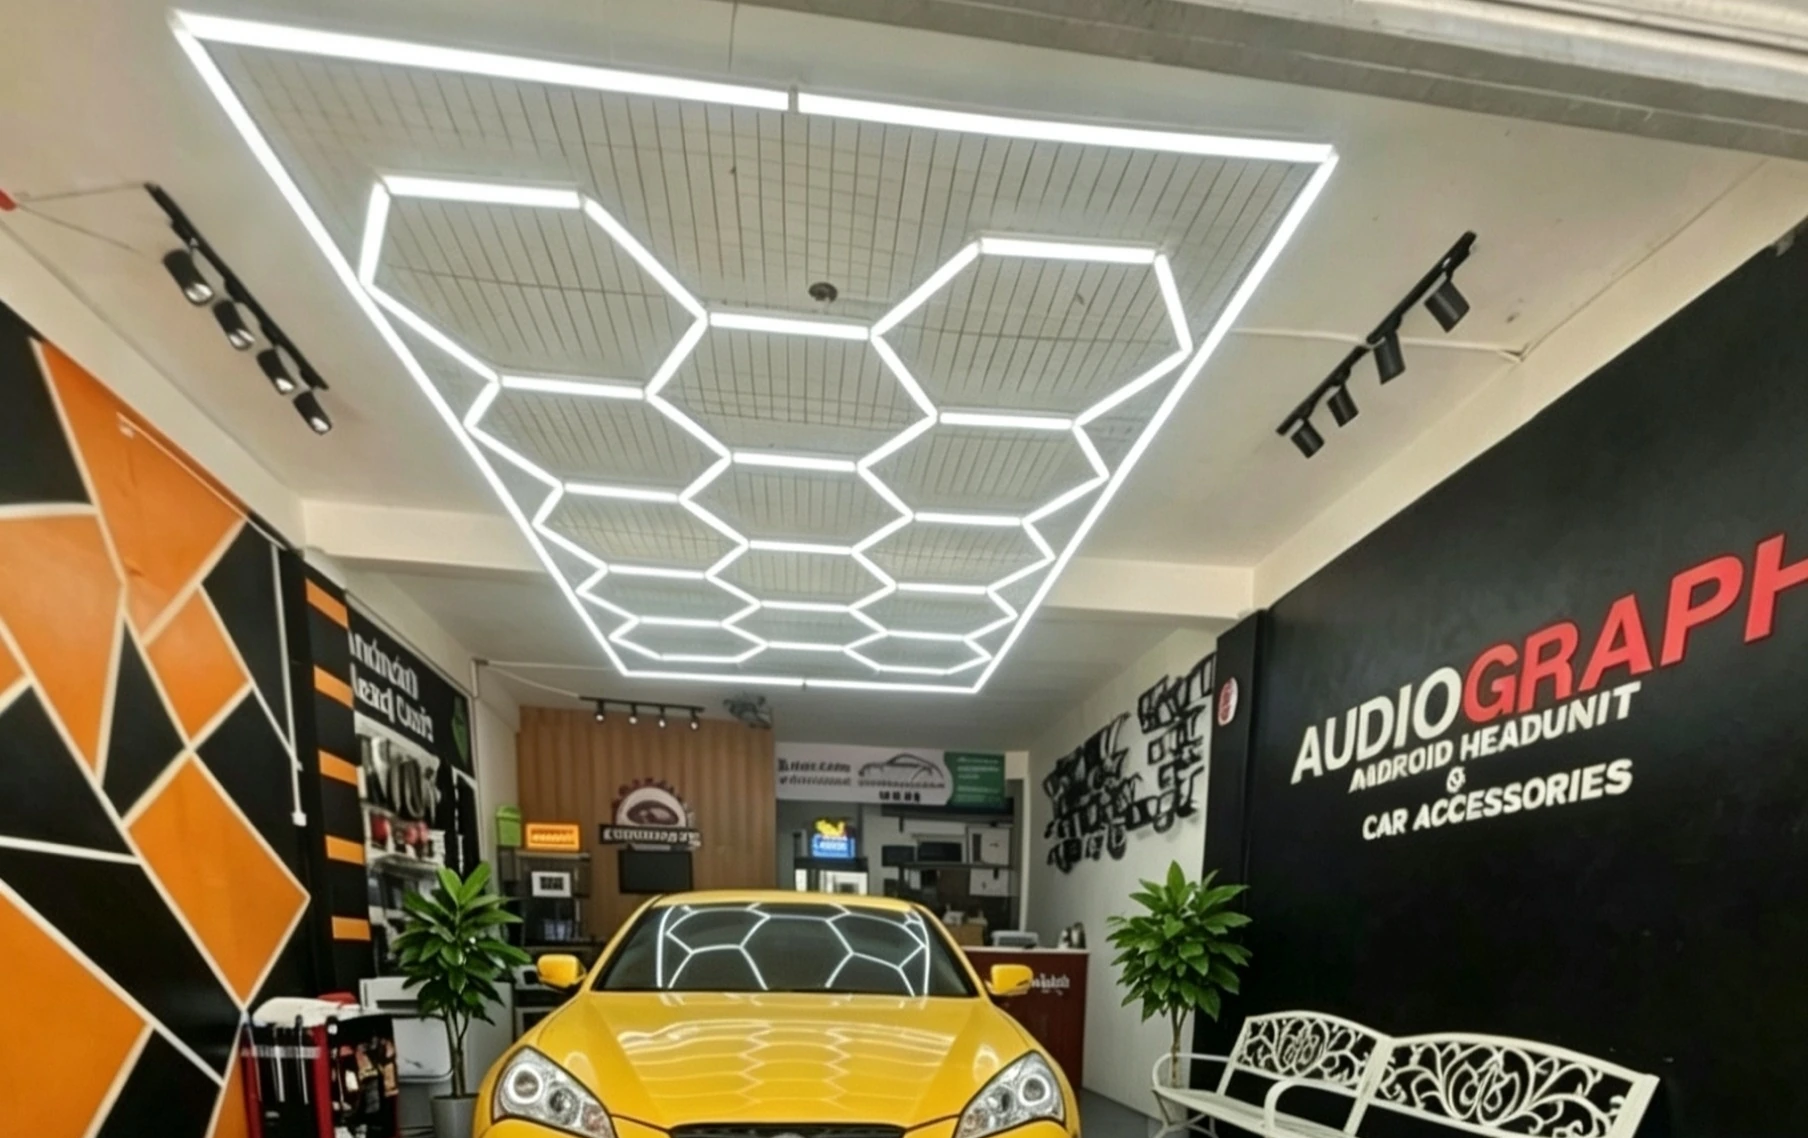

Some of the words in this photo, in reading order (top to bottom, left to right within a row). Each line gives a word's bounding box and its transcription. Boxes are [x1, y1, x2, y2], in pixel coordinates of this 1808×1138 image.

[1460, 680, 1642, 763] HEADUNIT
[1362, 807, 1409, 841] CAR
[1413, 758, 1634, 831] ACCESSORIES
